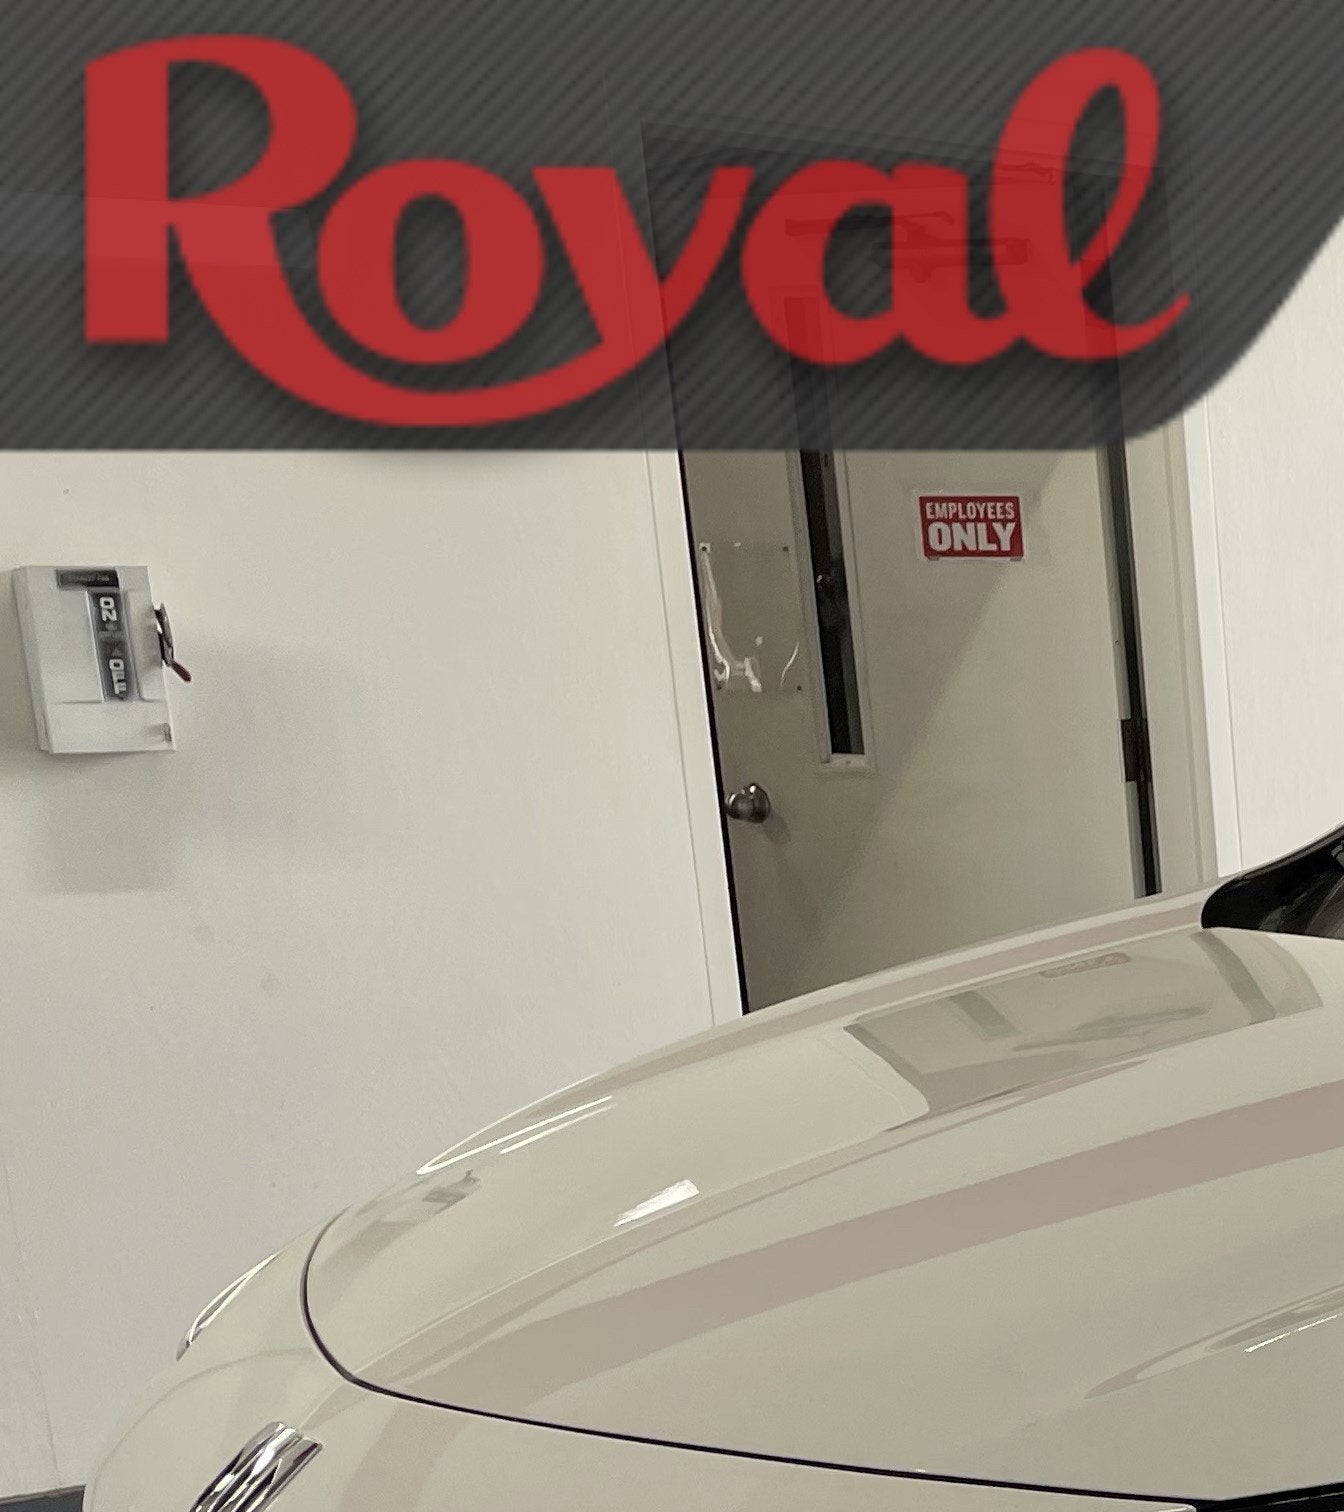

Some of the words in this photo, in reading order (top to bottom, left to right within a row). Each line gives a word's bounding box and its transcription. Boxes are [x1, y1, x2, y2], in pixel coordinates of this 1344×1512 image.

[925, 502, 1015, 519] EMPLOYEES
[928, 521, 1016, 552] ONLY
[99, 596, 118, 622] ON
[109, 658, 127, 695] OFF
